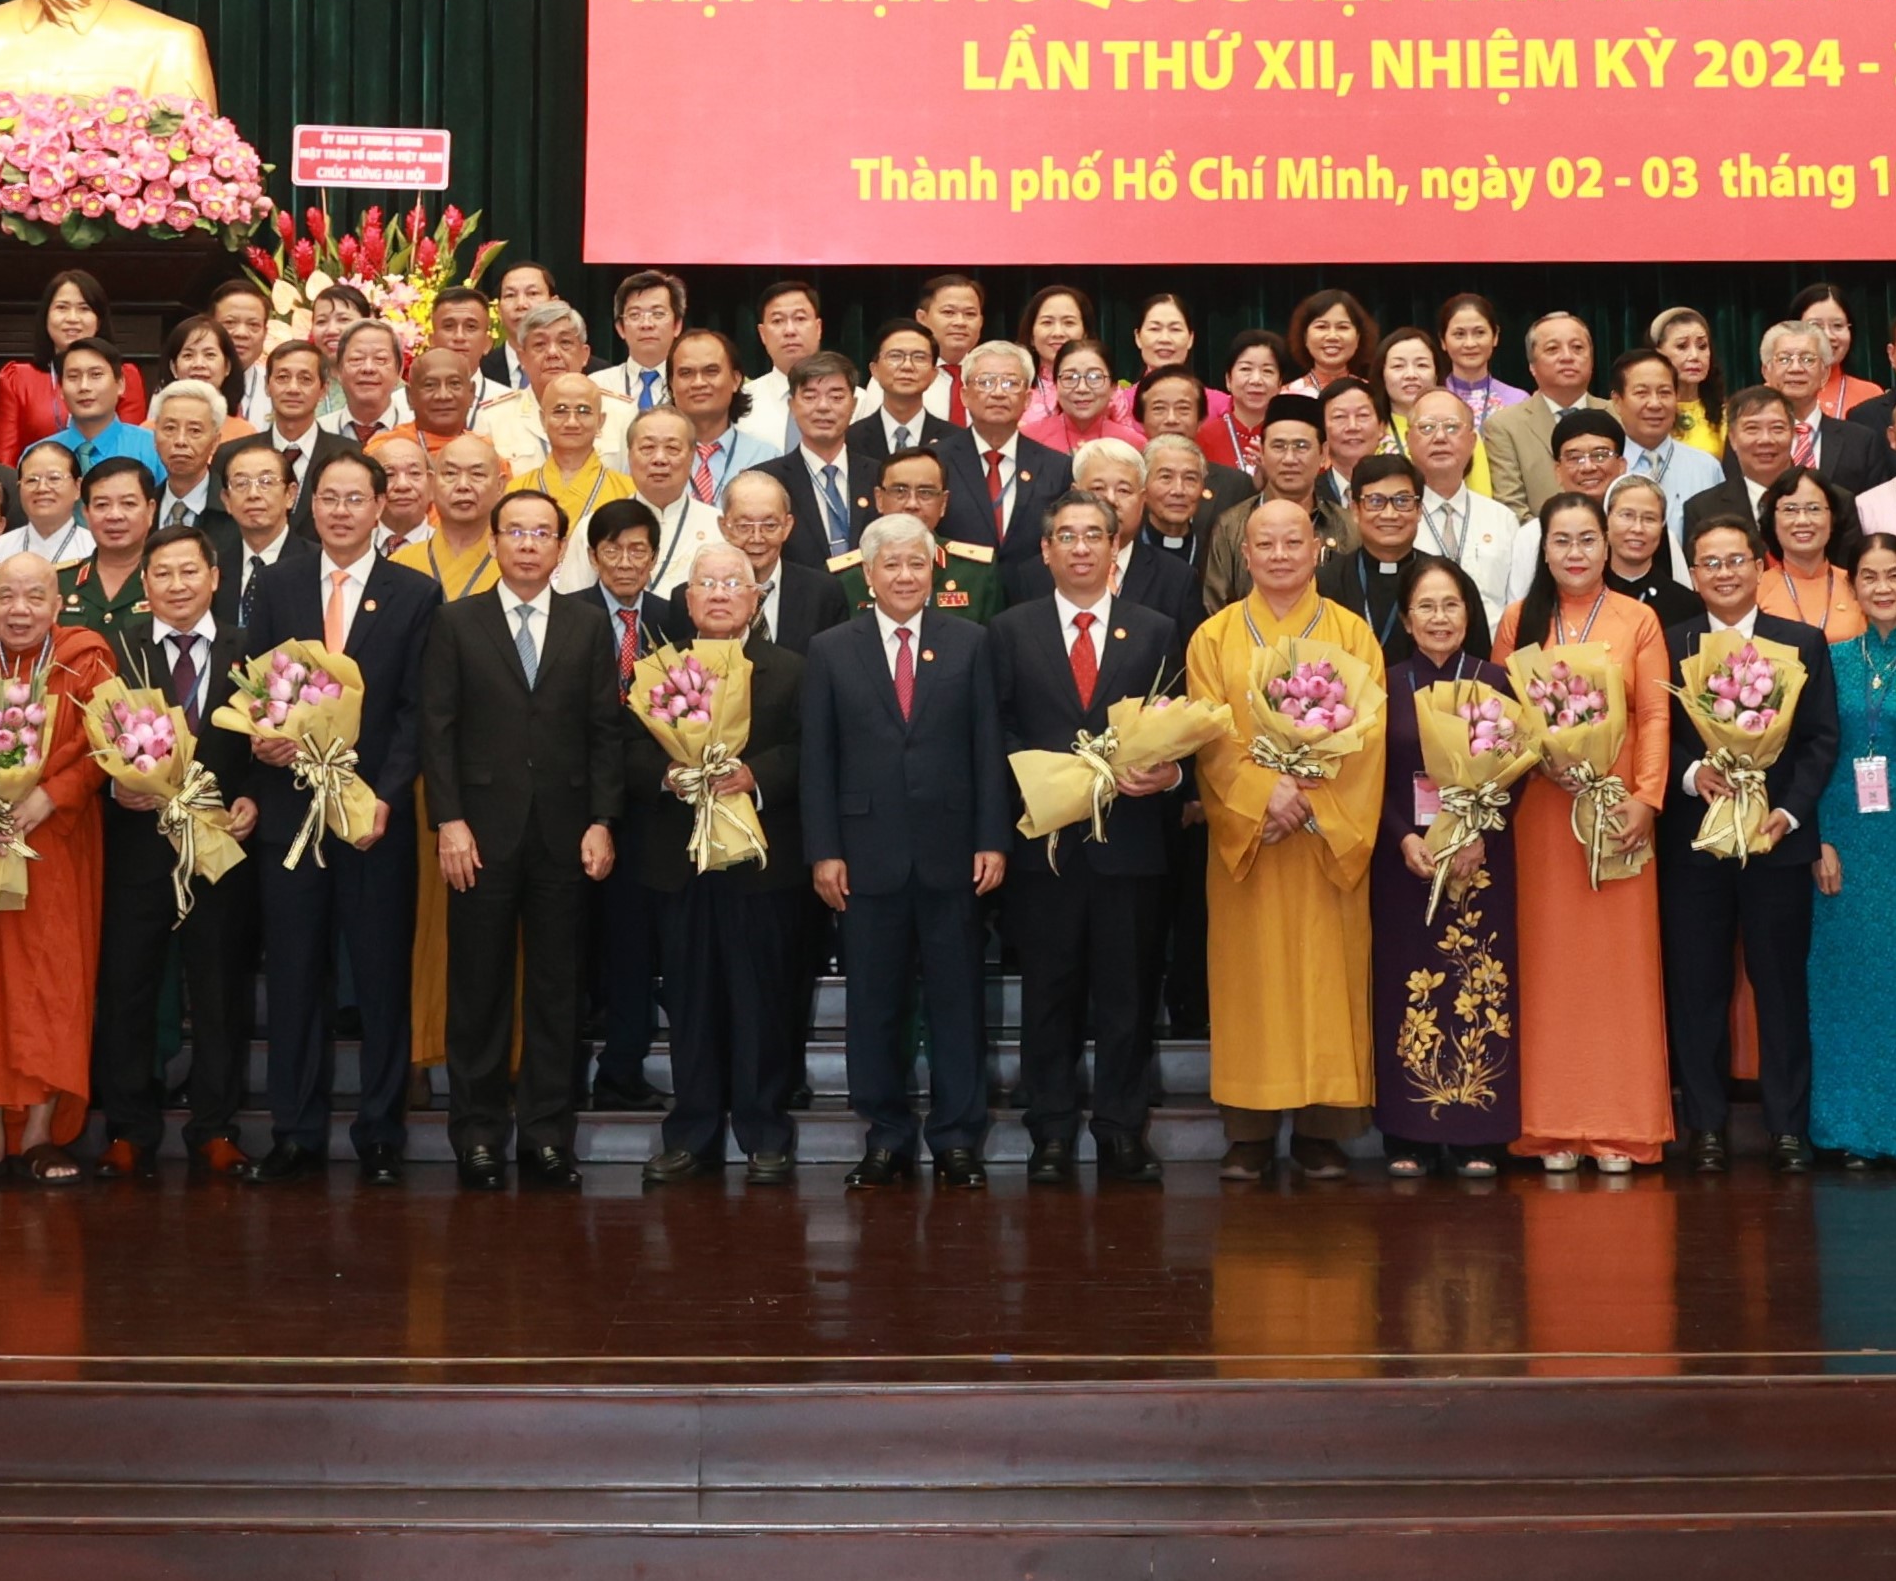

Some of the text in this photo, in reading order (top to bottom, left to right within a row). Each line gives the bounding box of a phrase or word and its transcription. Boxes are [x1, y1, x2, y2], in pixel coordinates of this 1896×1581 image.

[964, 24, 1090, 90] LẦN
[1102, 28, 1243, 91] THỨ
[1254, 39, 1354, 97] XII,
[1370, 27, 1579, 105] NHIỆM
[1594, 27, 1677, 88] KỲ
[1693, 38, 1846, 89] 2024
[1858, 62, 1880, 74] -
[851, 156, 998, 201] Thành
[1010, 150, 1102, 212] phố
[1112, 150, 1178, 201] Hồ
[1188, 155, 1266, 201] Chí
[1276, 155, 1409, 206] Minh,
[1421, 154, 1536, 211] ngày
[1546, 156, 1604, 199] 02
[1615, 177, 1631, 187] -
[1641, 156, 1699, 199] 03
[1719, 153, 1856, 209] tháng
